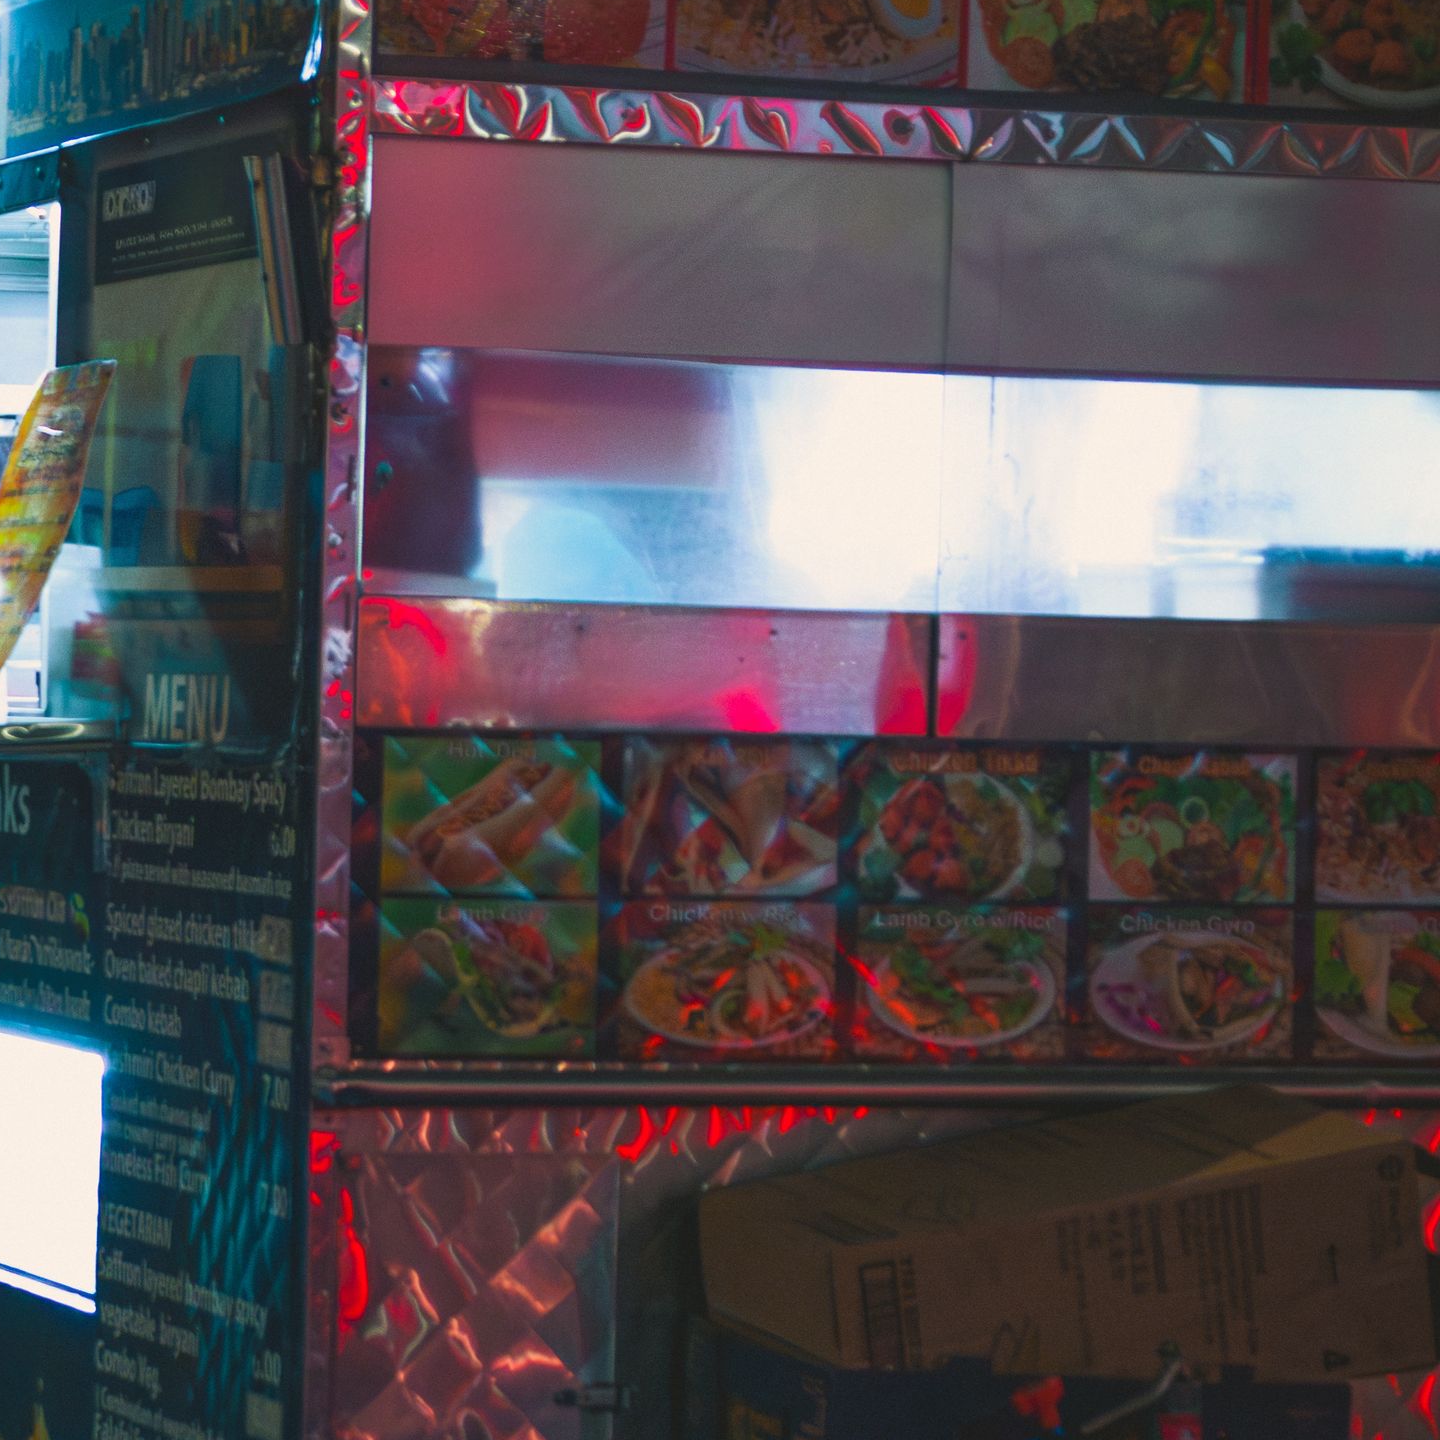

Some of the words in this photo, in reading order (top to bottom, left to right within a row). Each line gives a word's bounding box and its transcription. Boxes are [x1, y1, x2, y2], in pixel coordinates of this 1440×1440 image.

[143, 672, 230, 743] MENU
[200, 769, 251, 814] Bombay
[252, 771, 287, 817] Spicy
[111, 809, 153, 843] Chicken
[155, 813, 195, 854] Biryani
[105, 902, 146, 941] Spiced
[147, 907, 183, 947] glazed
[184, 912, 232, 951] chicken
[233, 918, 262, 954] tikk
[876, 910, 930, 929] Lamb
[1120, 914, 1201, 934] Chicken
[1205, 917, 1256, 938] Gyro
[104, 947, 137, 983] Oven
[138, 953, 173, 990] baked
[211, 963, 250, 1003] kebab
[104, 994, 146, 1032] Combo
[147, 1000, 182, 1039] kebab
[156, 1050, 201, 1090] Chicken
[202, 1060, 236, 1107] Curry
[154, 1152, 177, 1190] Fish
[100, 1198, 173, 1250] VEGETARIAN
